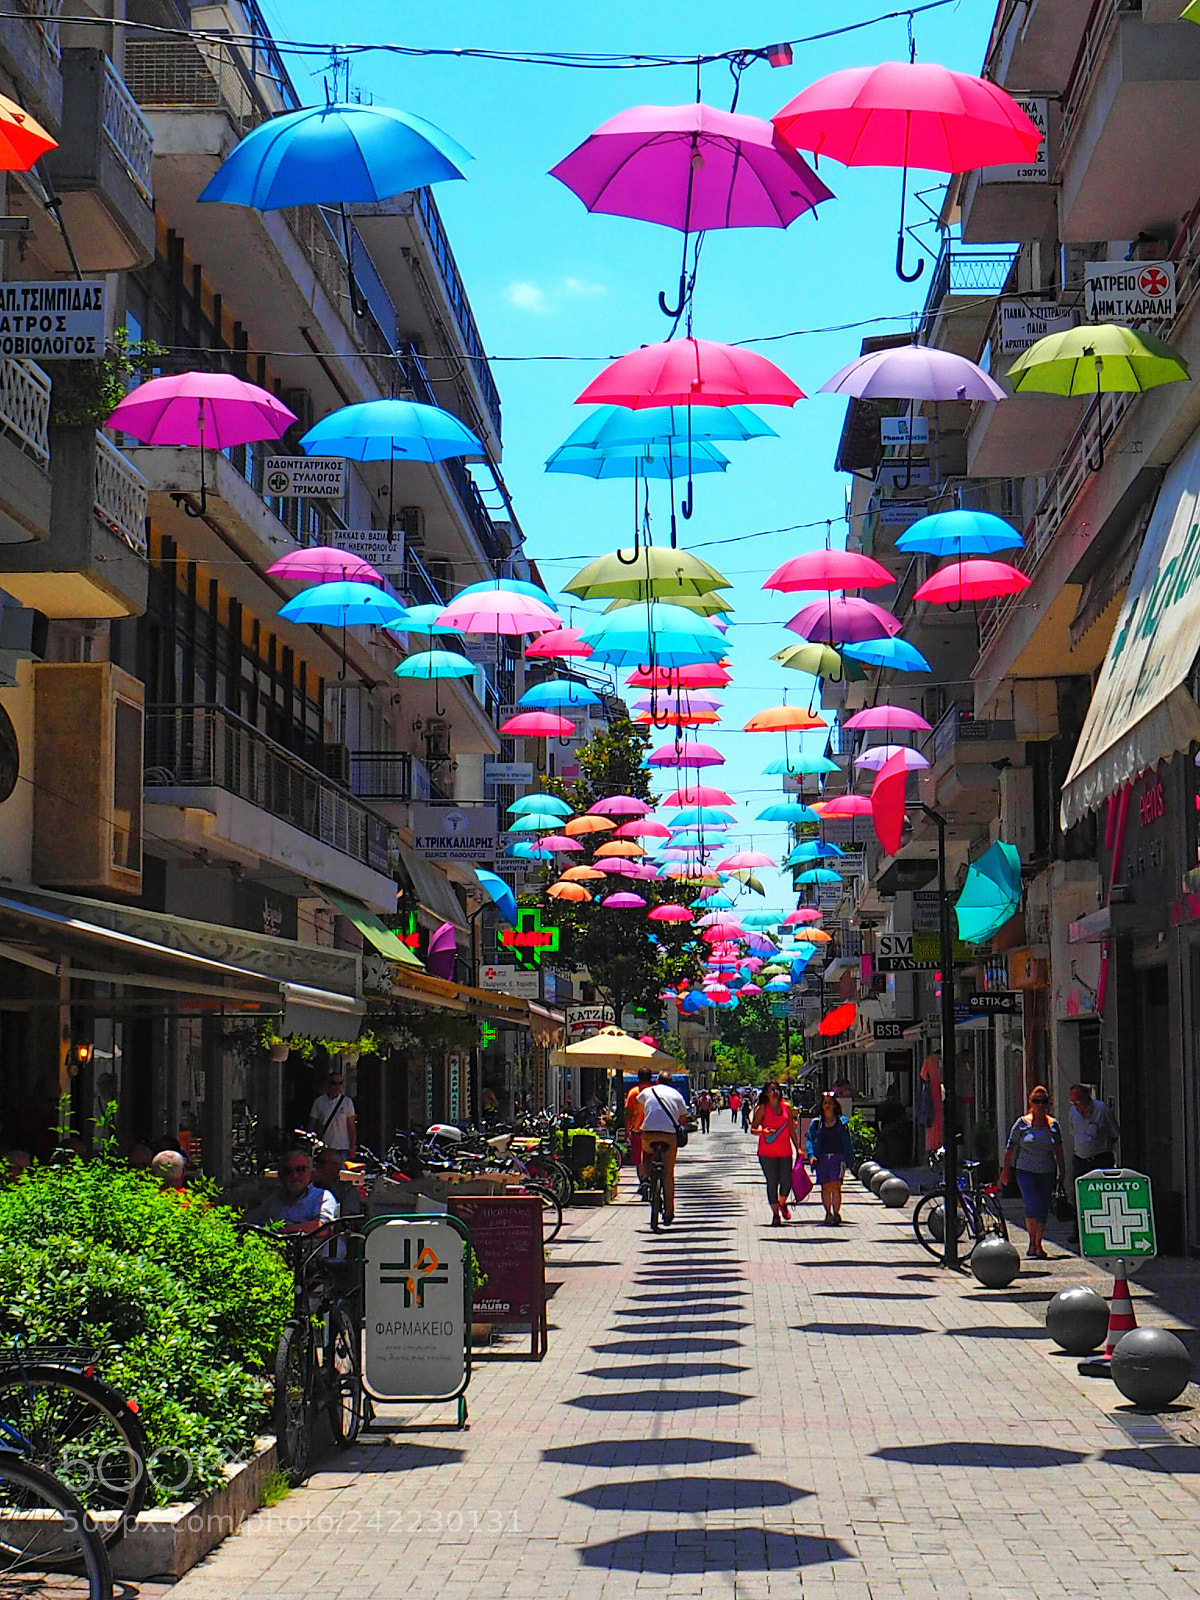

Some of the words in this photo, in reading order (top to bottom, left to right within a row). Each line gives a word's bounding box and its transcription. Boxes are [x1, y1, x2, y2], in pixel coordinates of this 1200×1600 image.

[0, 337, 96, 354] ΟΒΙΟΛΟΓΟΣ
[267, 461, 343, 470] ΟΔΟΝΤΙΑΤΡΙΚΟΣ
[293, 473, 341, 482] ΣΥΛΛΟΓΟΣ
[293, 485, 340, 494] ΤΡΙΚΑΛΩΝ
[970, 997, 1001, 1006] ΦΕΤΙΧ
[876, 1024, 901, 1036] BSB
[375, 1321, 454, 1336] ΦΑΡΜΑΚΕΙΟ
